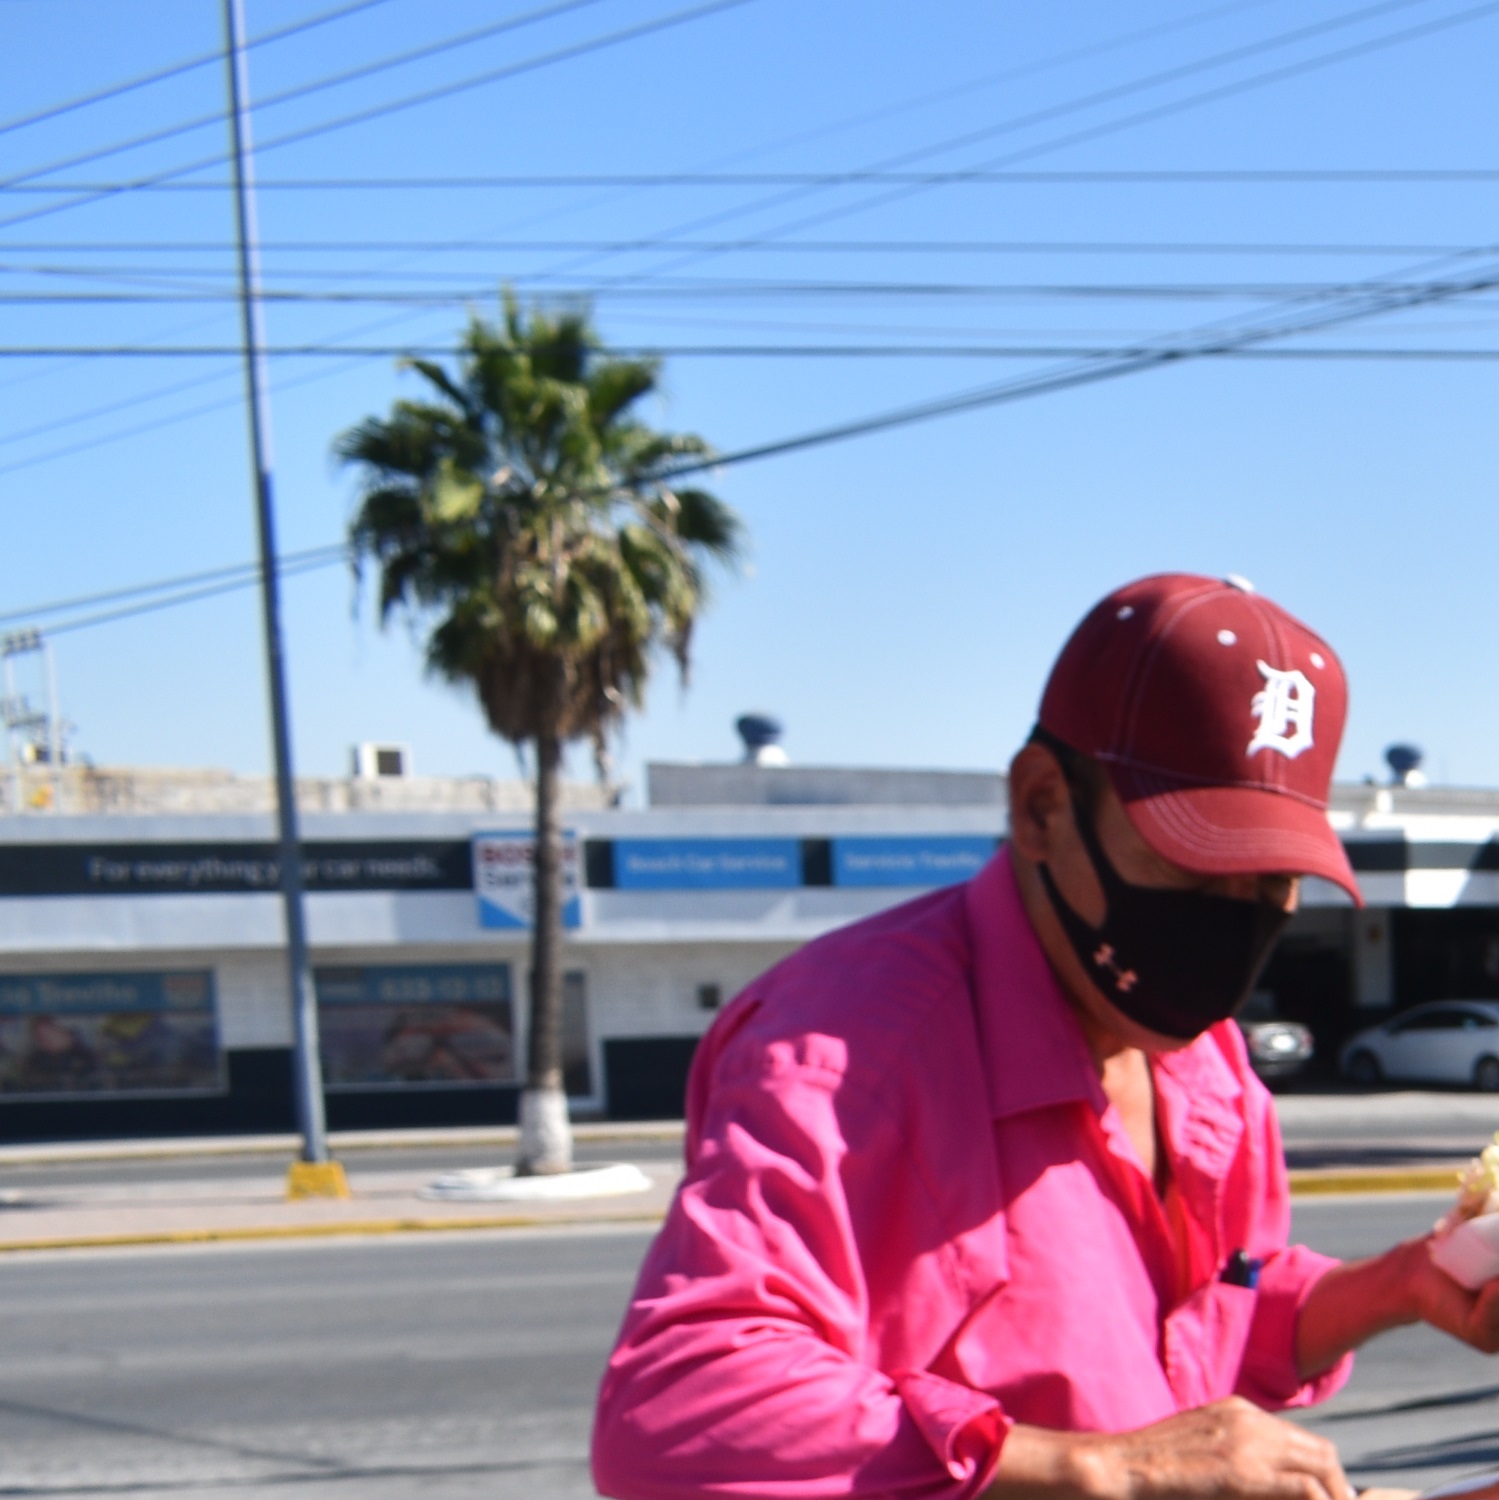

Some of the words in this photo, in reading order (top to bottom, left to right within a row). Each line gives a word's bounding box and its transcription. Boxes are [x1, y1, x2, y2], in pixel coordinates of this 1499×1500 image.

[1245, 659, 1316, 759] D
[87, 856, 130, 881] For
[134, 856, 263, 886] everything
[322, 859, 361, 880] car
